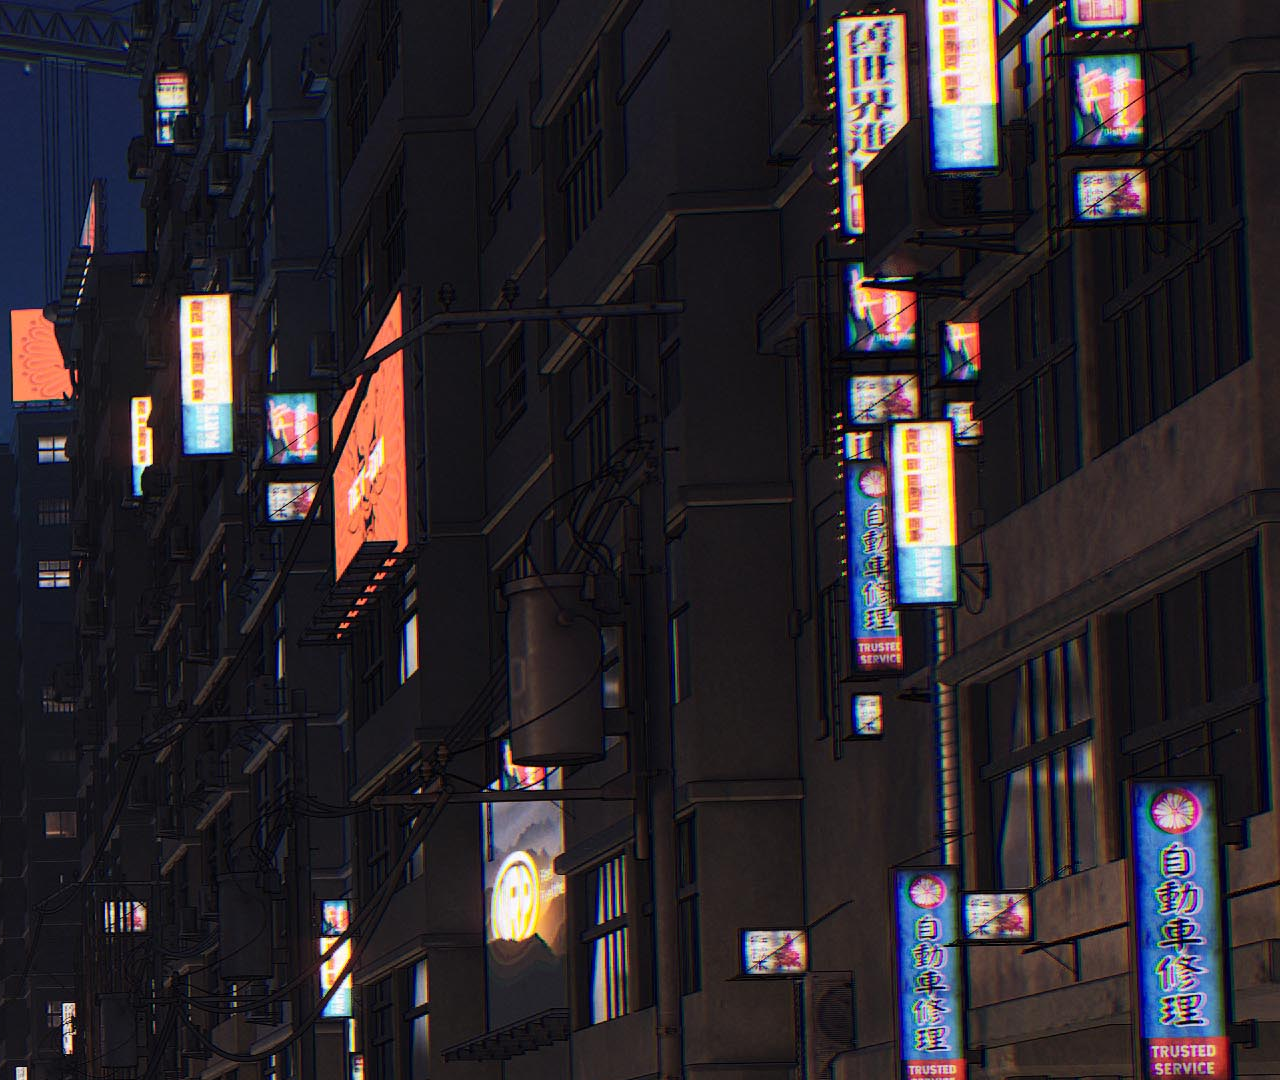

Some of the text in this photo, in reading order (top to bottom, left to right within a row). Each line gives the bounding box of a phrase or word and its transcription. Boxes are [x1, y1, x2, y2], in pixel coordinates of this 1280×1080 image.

[204, 404, 221, 449] PARTS
[1155, 842, 1209, 1028] 自動車修理
[912, 915, 951, 1052] 自動車修理
[1150, 1045, 1216, 1058] TRUSTED
[908, 1064, 957, 1076] TRUSTED
[1155, 1061, 1215, 1076] SERVICE
